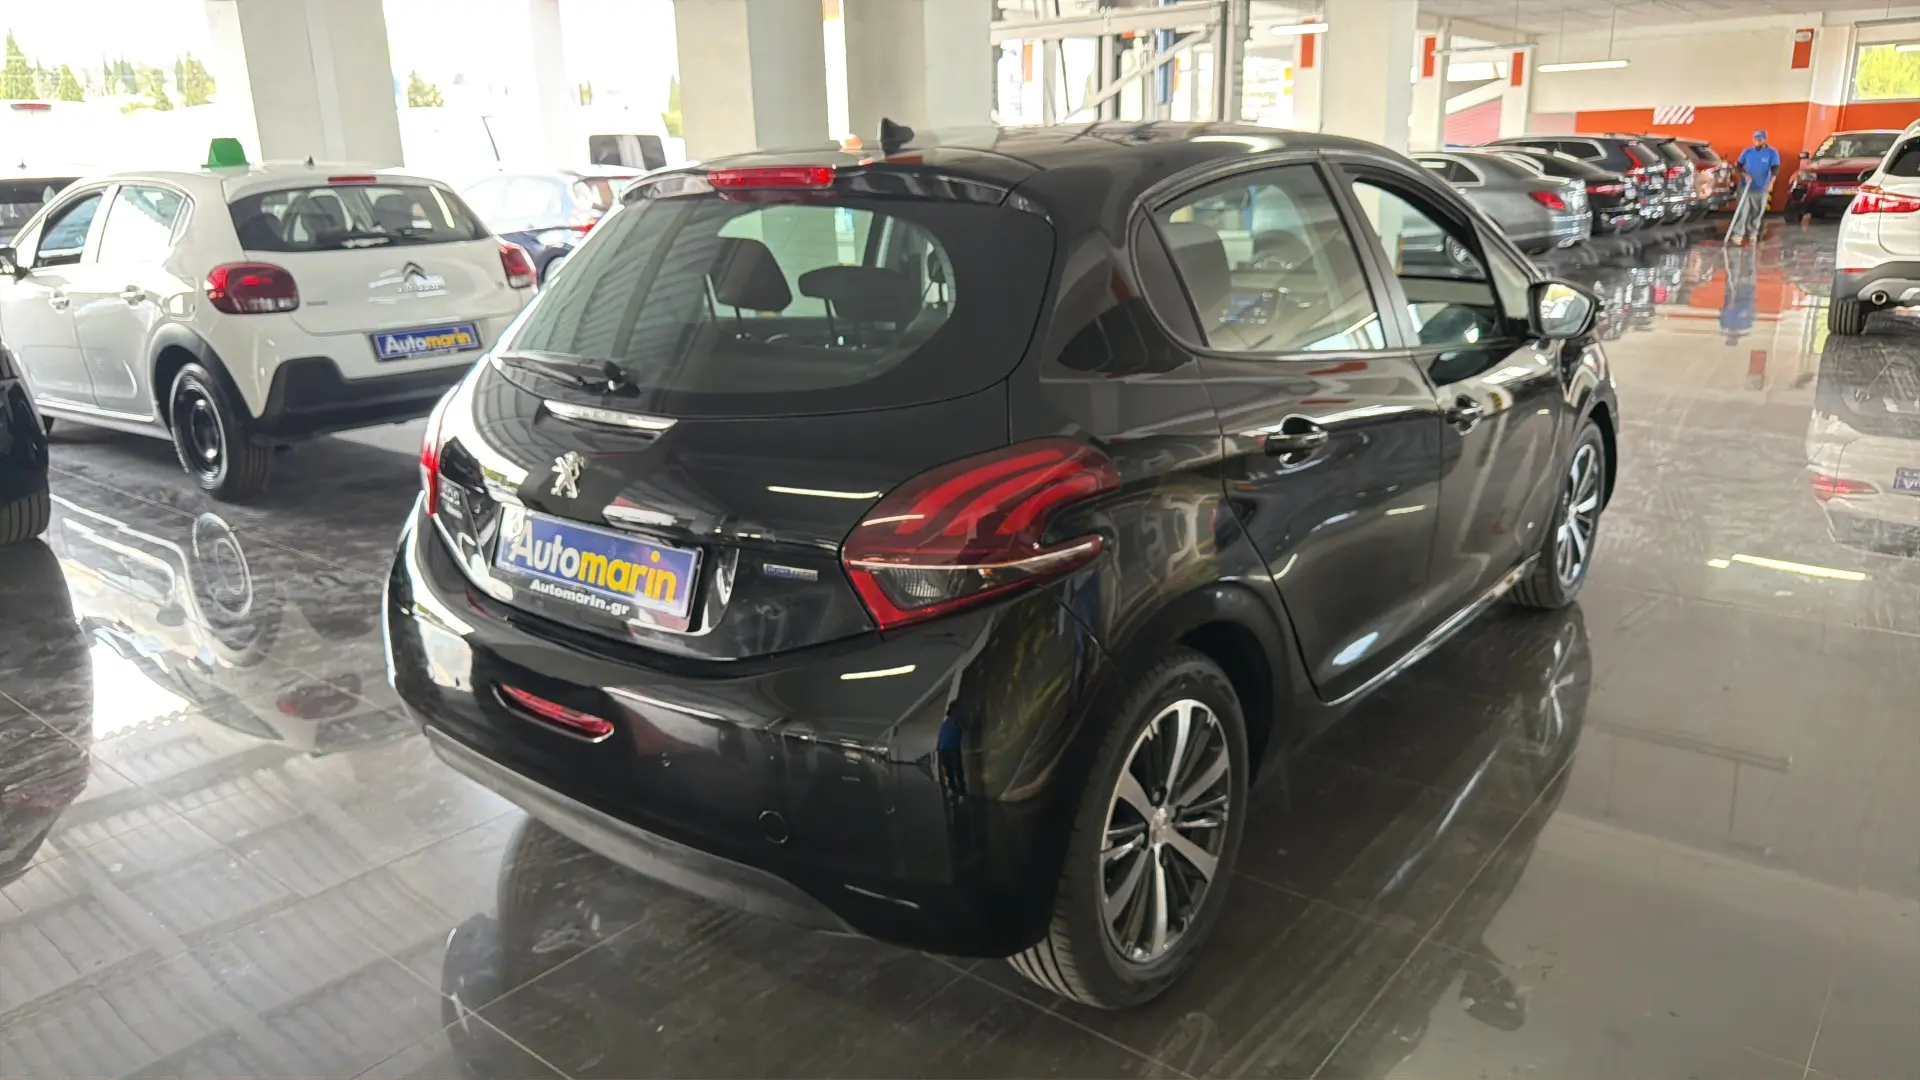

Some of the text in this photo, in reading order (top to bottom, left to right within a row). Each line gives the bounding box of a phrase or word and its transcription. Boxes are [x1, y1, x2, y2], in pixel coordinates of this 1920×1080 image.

[385, 327, 472, 355] Automarin
[508, 520, 677, 604] Automarin
[529, 579, 630, 616] Automarin.gr
